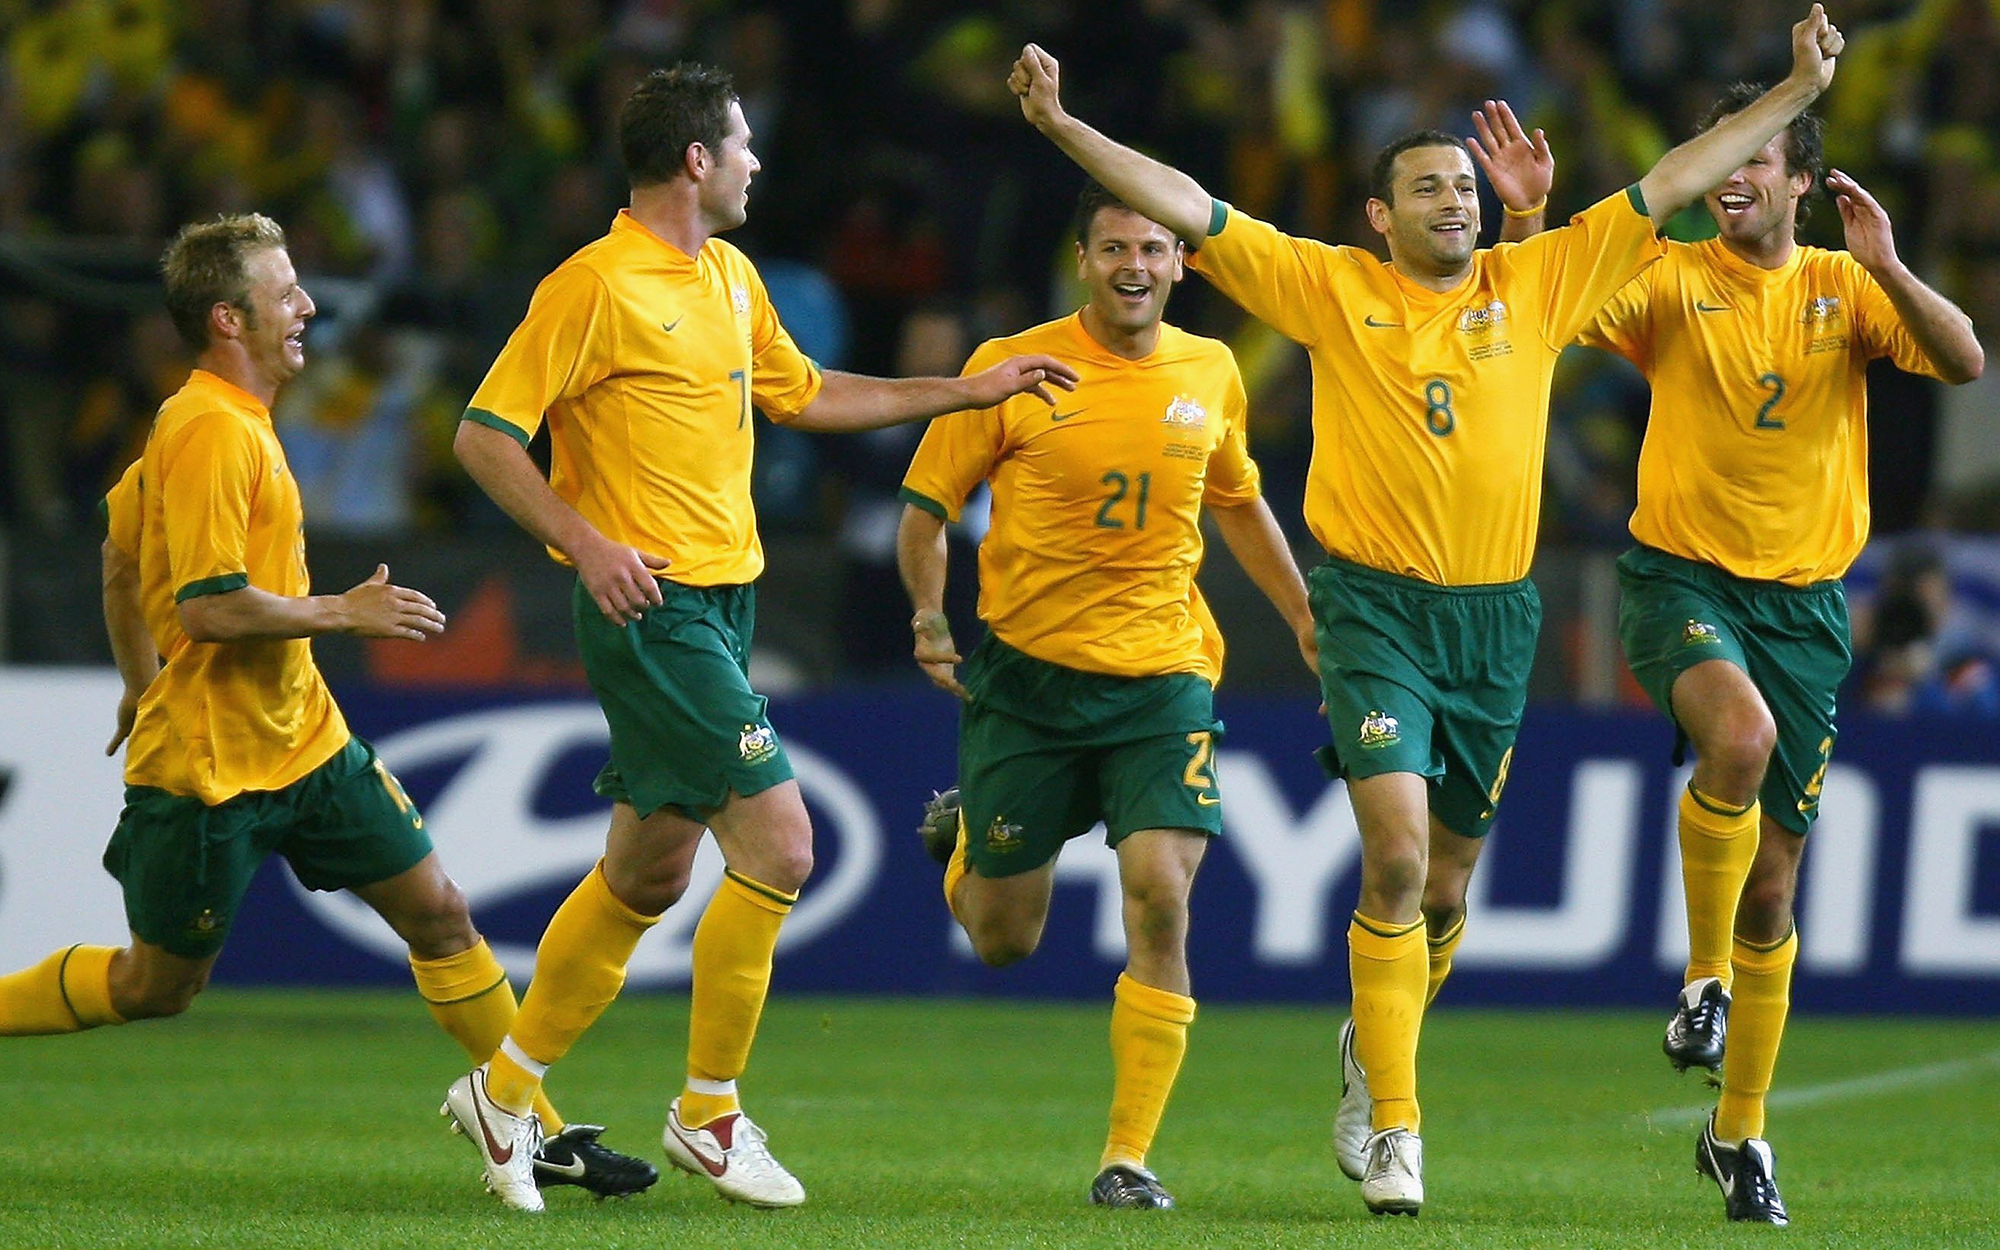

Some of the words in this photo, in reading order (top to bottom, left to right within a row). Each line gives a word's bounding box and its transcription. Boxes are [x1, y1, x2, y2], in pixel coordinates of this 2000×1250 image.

[729, 369, 746, 430] 7
[1425, 379, 1454, 437] 8
[1755, 373, 1786, 430] 2
[1095, 470, 1150, 530] 21
[1183, 731, 1215, 789] 2
